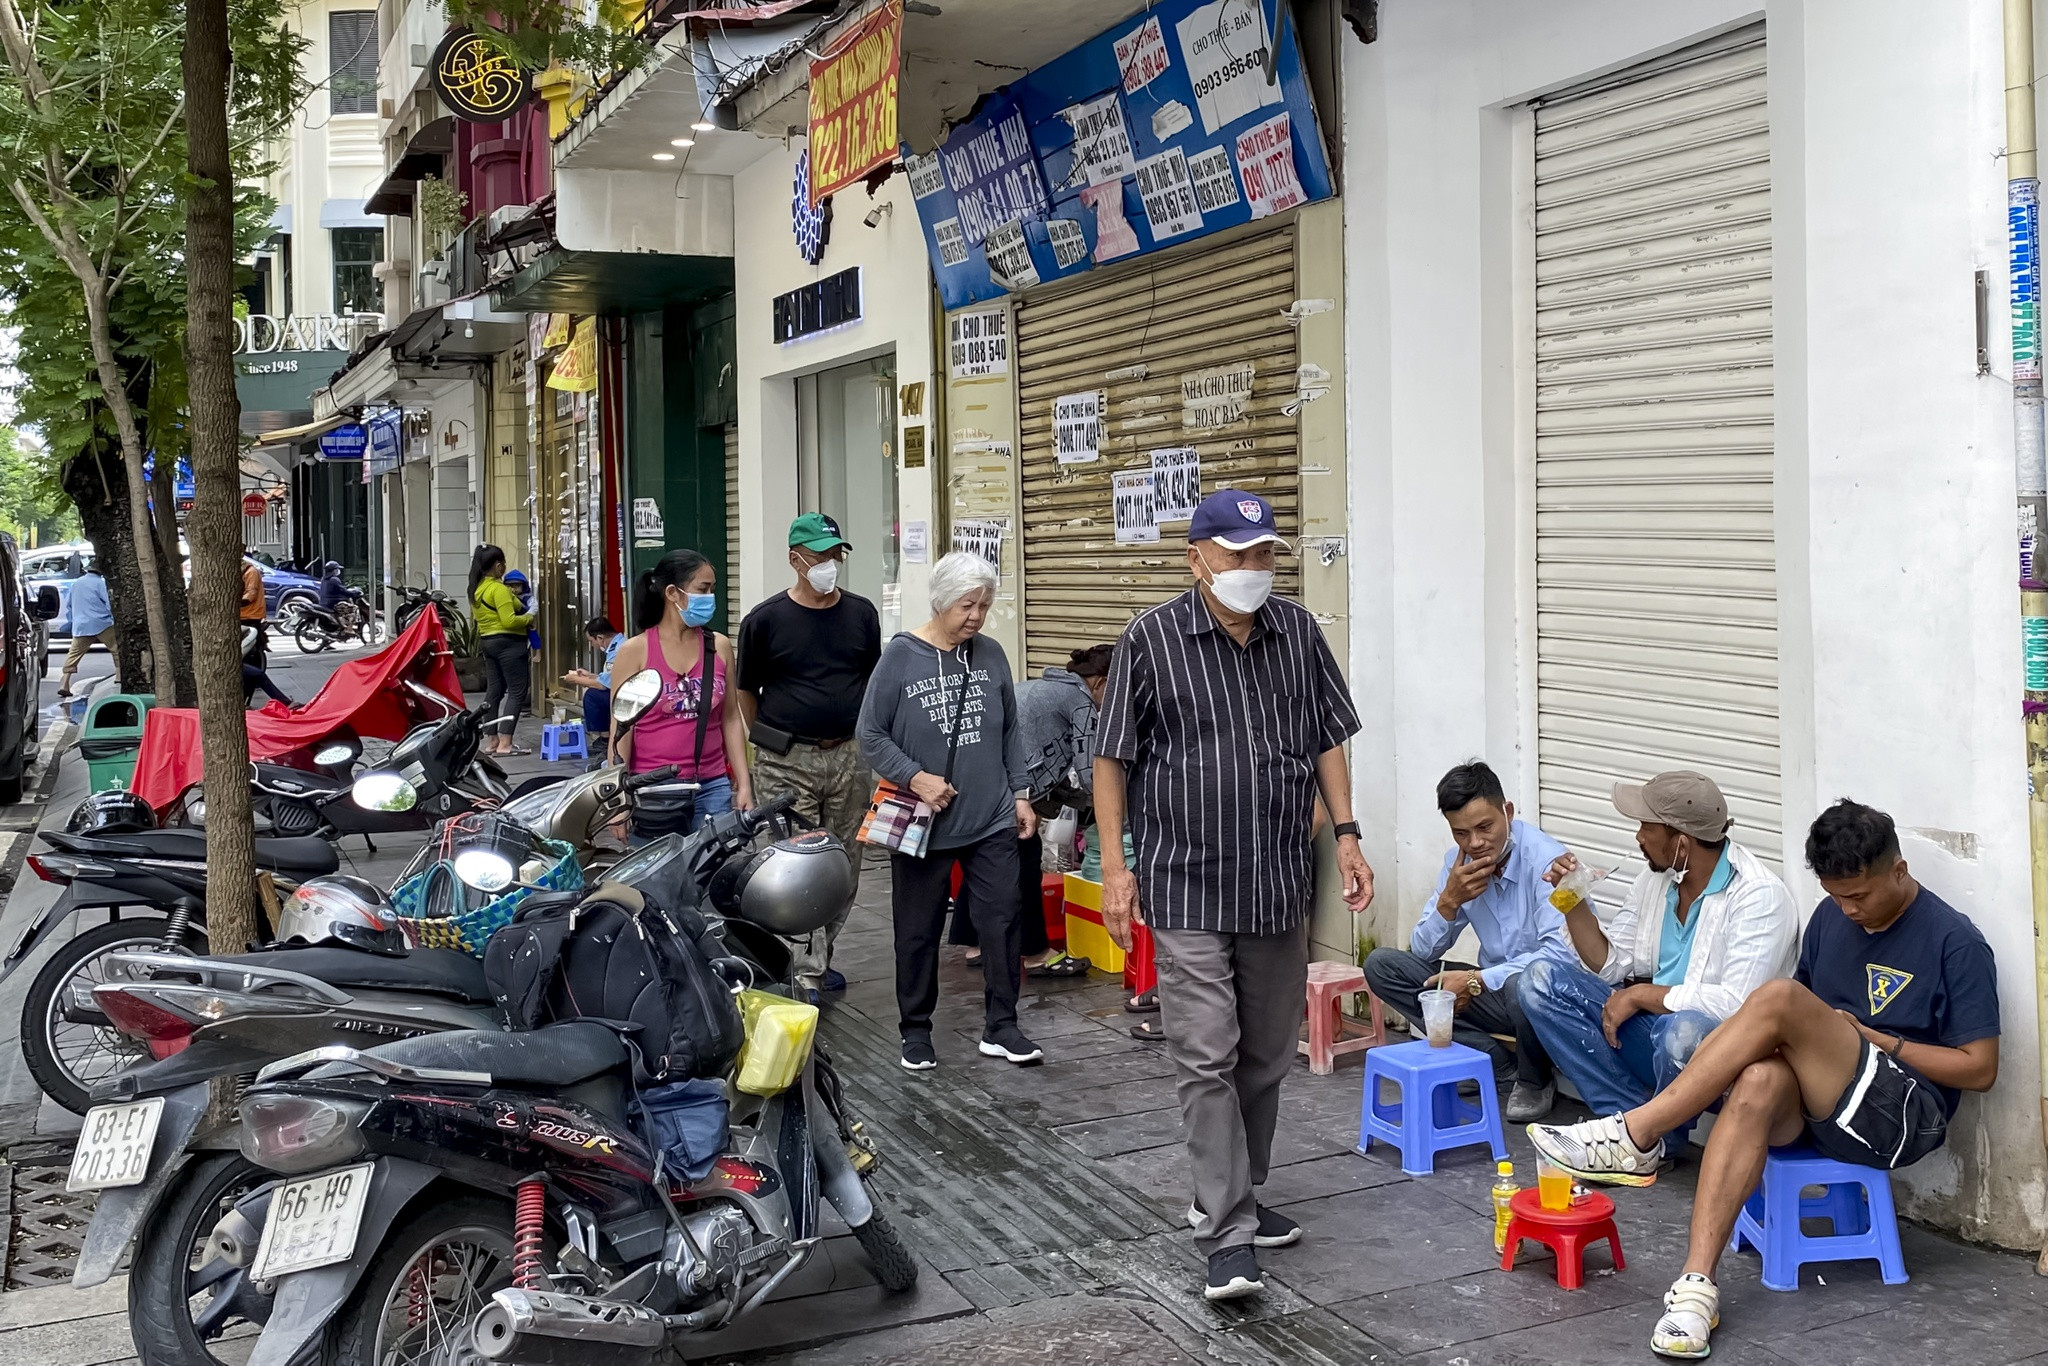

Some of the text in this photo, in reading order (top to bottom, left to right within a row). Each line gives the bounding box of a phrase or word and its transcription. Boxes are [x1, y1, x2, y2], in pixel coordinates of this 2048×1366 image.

[1192, 36, 1209, 56] CHO
[1194, 49, 1262, 99] 0903 956 50
[1237, 137, 1256, 162] CHO
[1273, 114, 1290, 145] NHÀ
[945, 146, 974, 192] CHO
[967, 118, 1005, 178] THUÊ
[1136, 166, 1154, 197] CHO
[963, 316, 980, 339] CHO
[983, 309, 1005, 337] THUÊ
[969, 341, 986, 364] 088
[989, 338, 1006, 361] 540
[272, 360, 298, 373] 1948
[1204, 375, 1224, 397] CHO
[1059, 405, 1070, 420] CHO
[1155, 455, 1168, 468] CHO
[1144, 477, 1153, 486] THU
[1116, 493, 1158, 529] 0917.111.66
[905, 669, 991, 699] EARLY MORNNGS,
[920, 690, 953, 708] MESSY
[947, 730, 981, 748] CFFEE
[92, 1106, 149, 1145] 83-E1
[75, 1143, 147, 1184] 203.36
[279, 1173, 354, 1222] 66-H9
